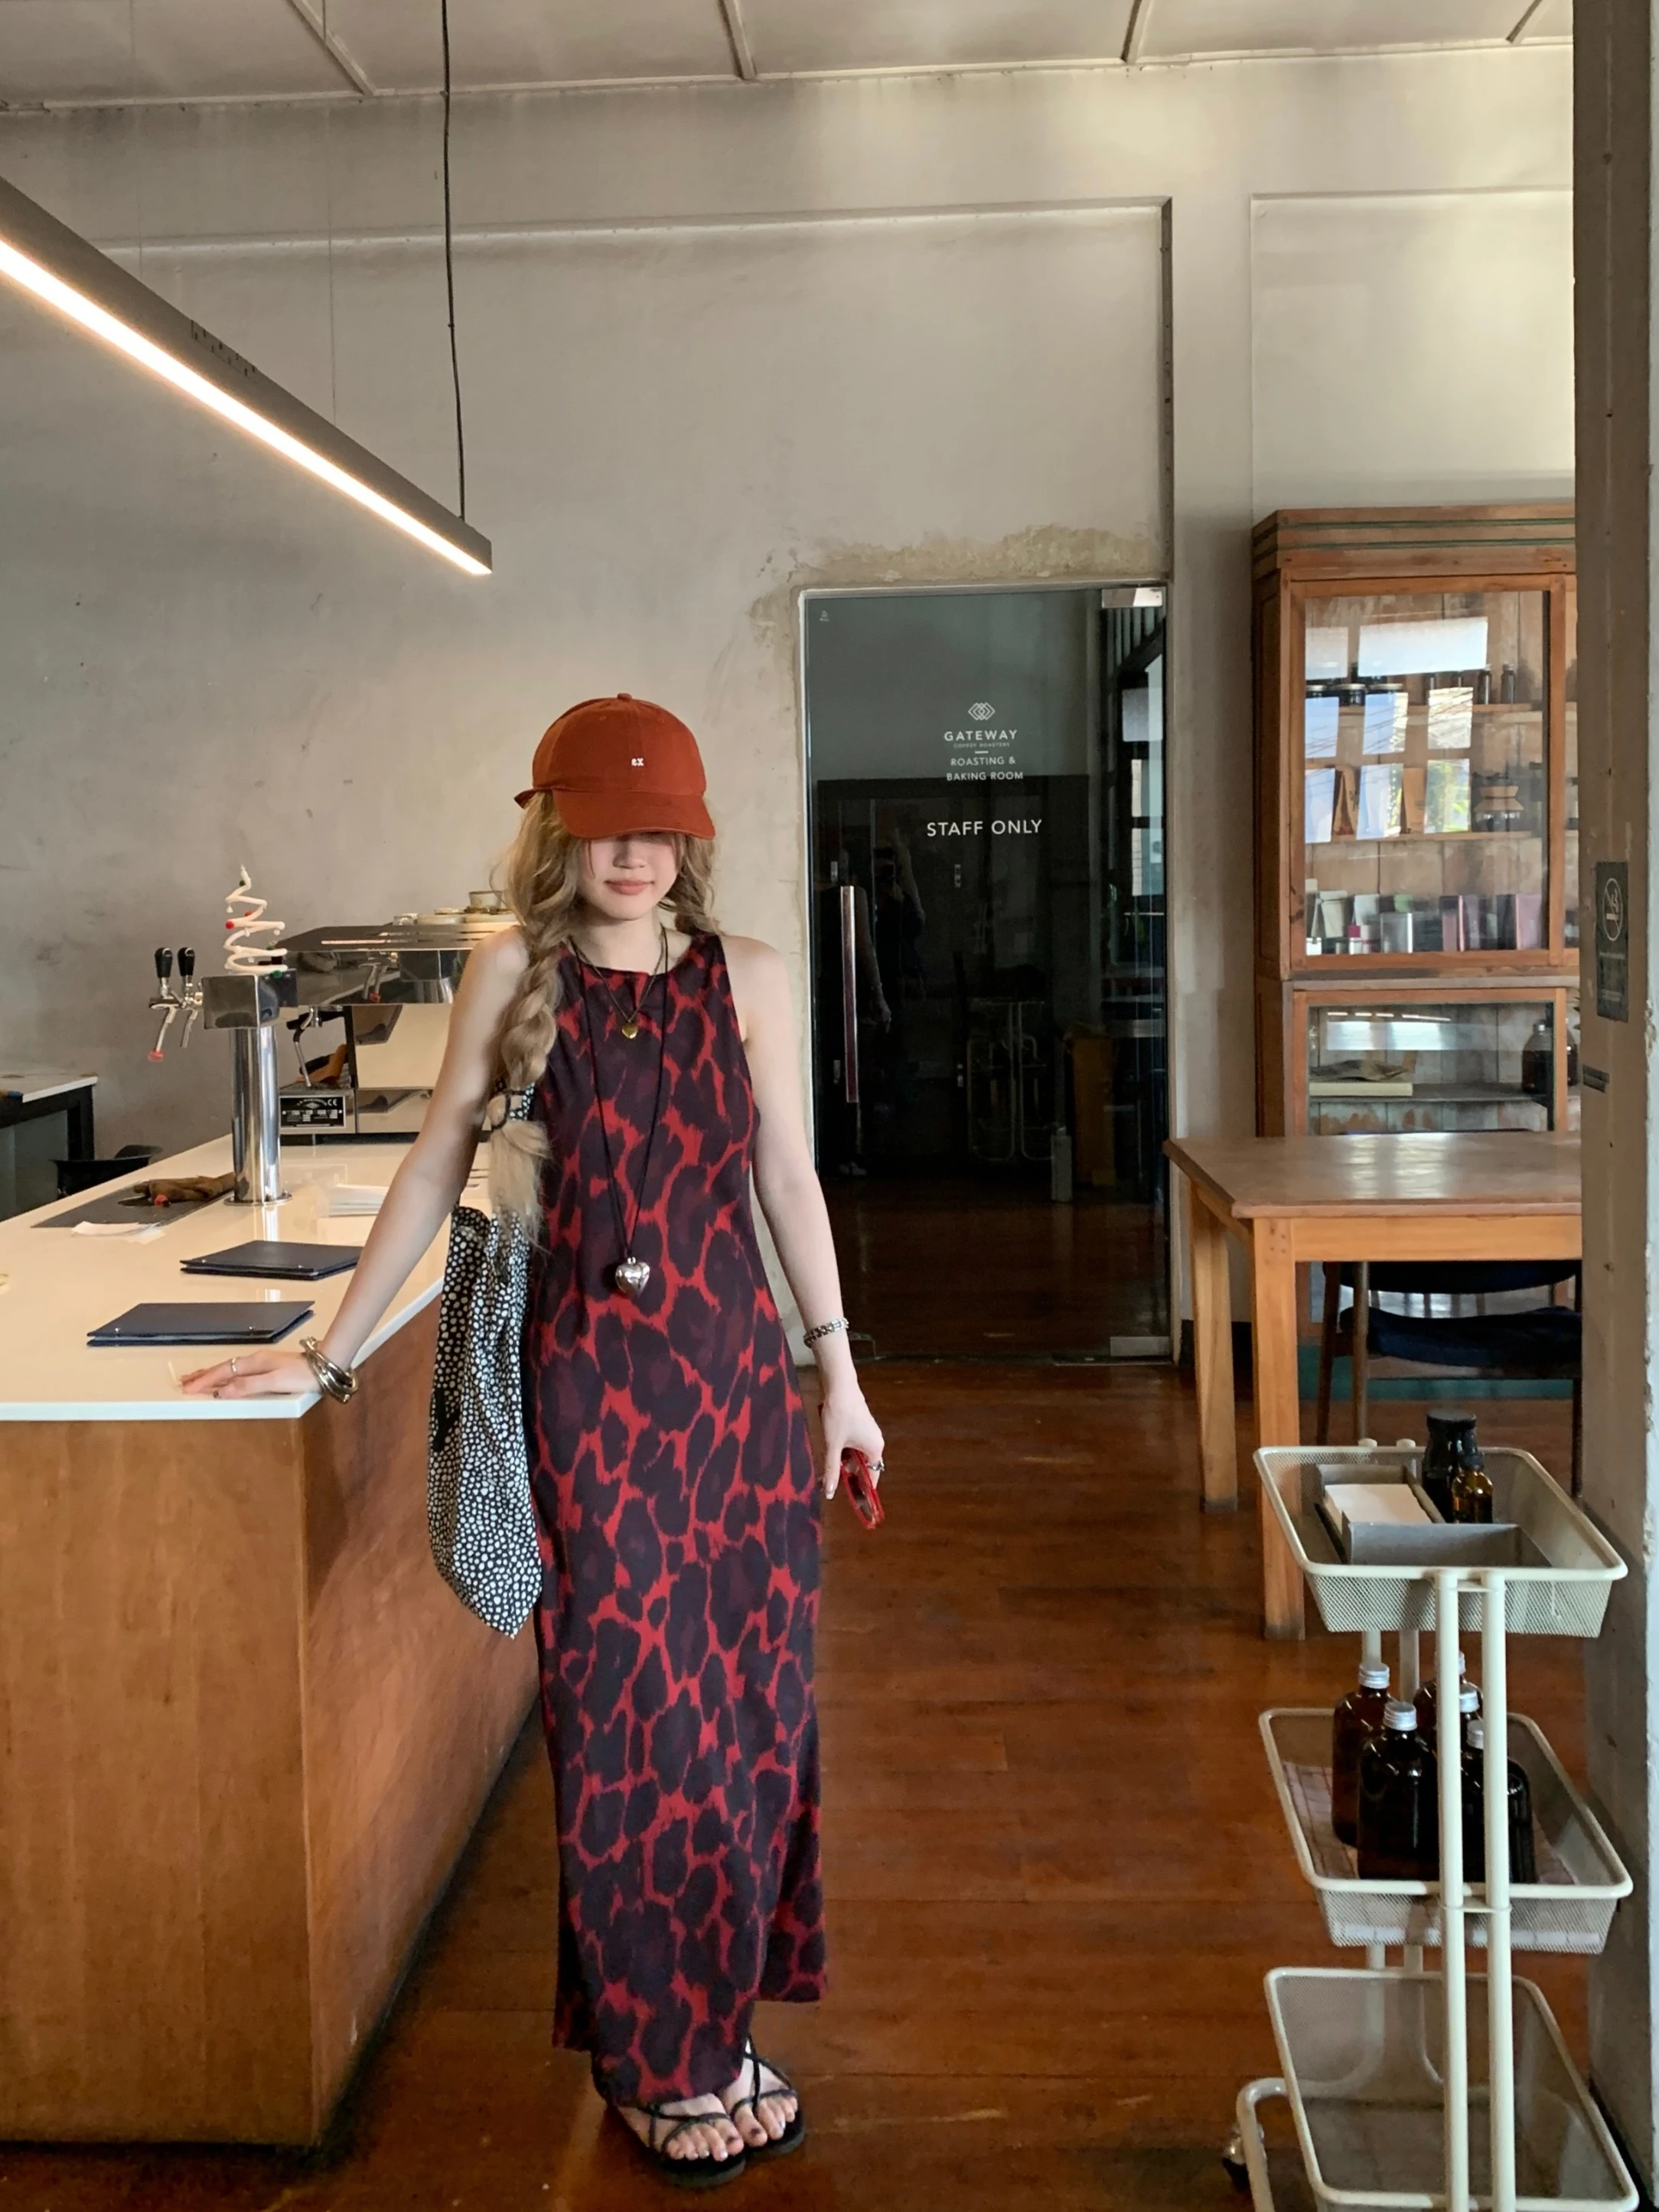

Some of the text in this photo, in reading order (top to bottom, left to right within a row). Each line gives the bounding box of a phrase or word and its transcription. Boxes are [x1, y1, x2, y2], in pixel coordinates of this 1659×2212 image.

[944, 730, 1018, 741] GATEWAY
[950, 756, 1015, 766] ROASTING &
[946, 771, 1023, 781] BAKING ROOM
[927, 819, 1042, 837] STAFF ONLY
